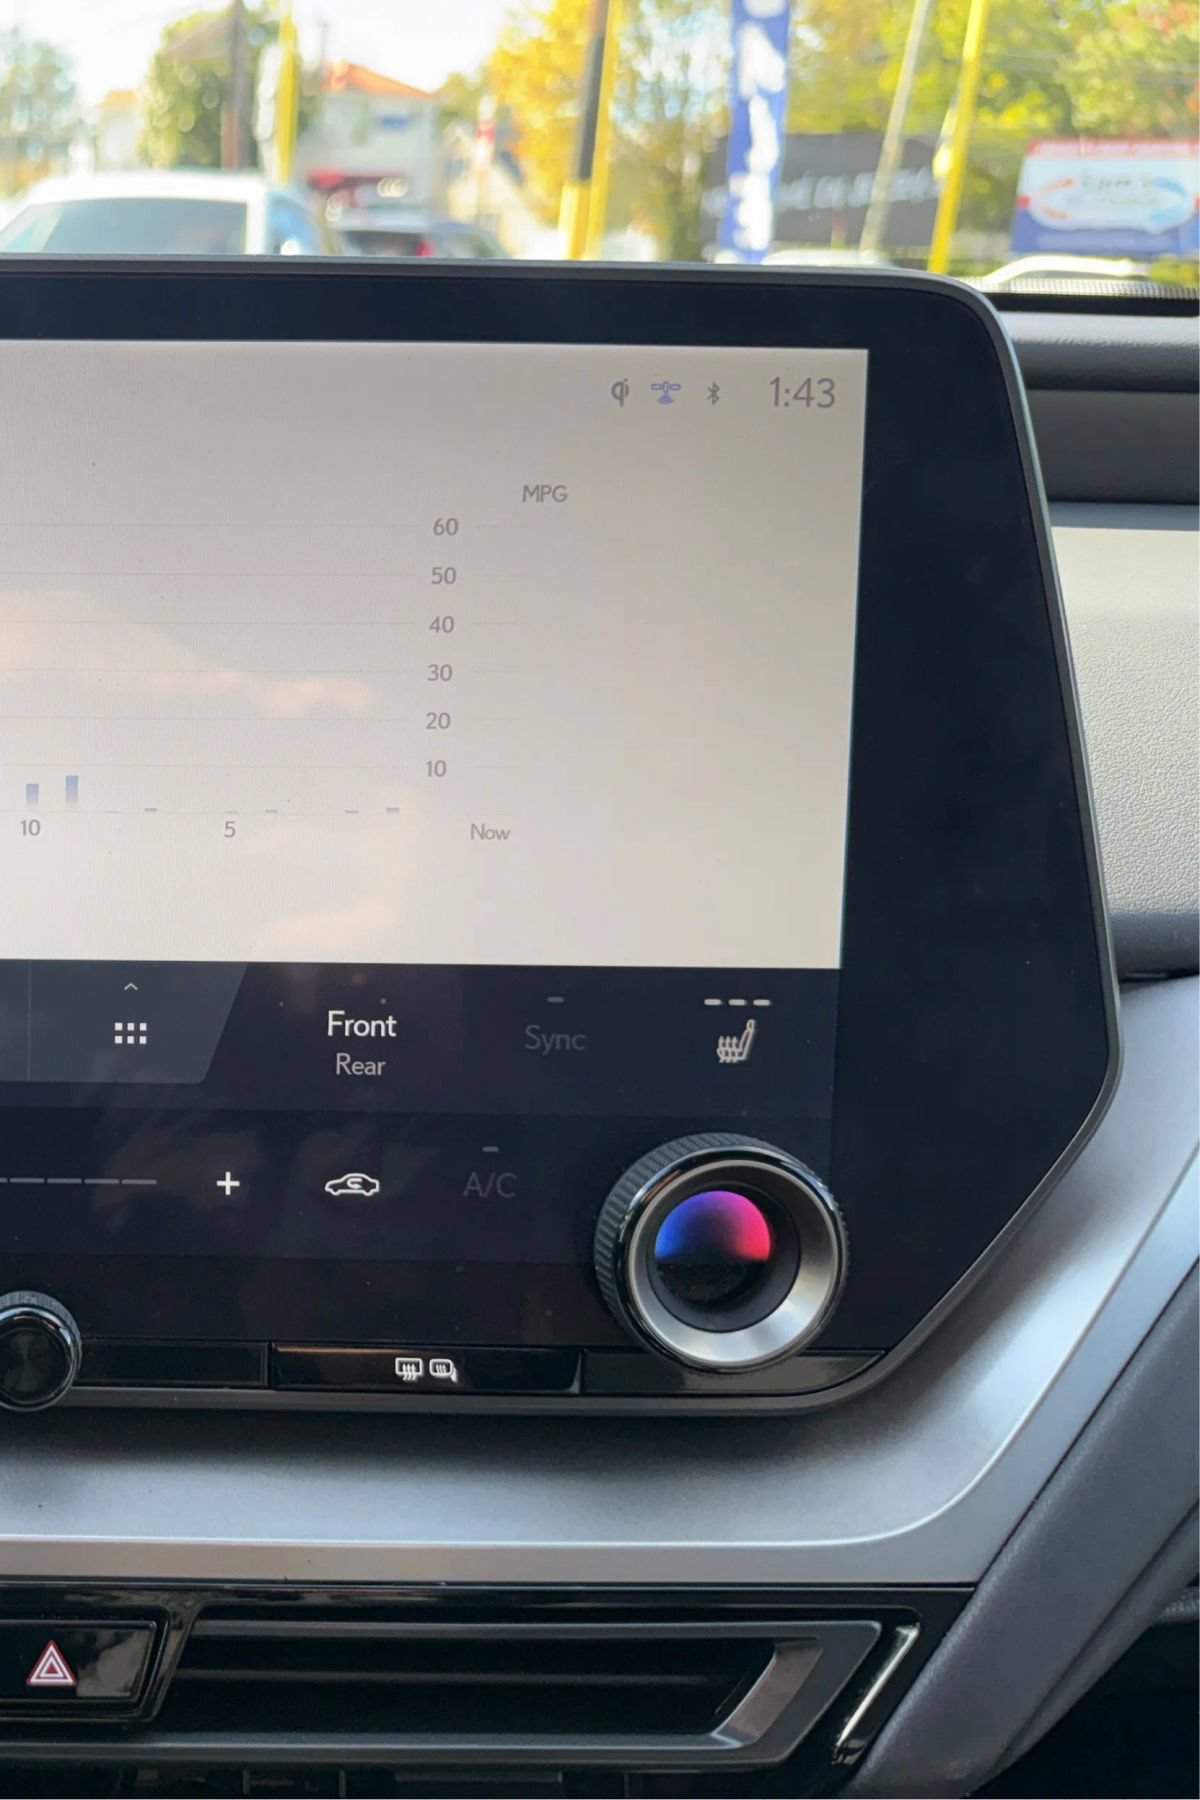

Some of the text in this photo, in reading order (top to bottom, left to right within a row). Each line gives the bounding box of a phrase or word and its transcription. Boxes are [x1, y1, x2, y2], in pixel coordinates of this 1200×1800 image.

[770, 376, 836, 409] 1:43
[521, 484, 569, 503] MPG
[432, 517, 459, 537] 60
[431, 566, 457, 585] 50
[428, 615, 455, 634] 40
[426, 663, 453, 682] 30
[425, 711, 451, 730] 20
[425, 759, 447, 778] 10
[20, 818, 41, 837] 10
[223, 820, 237, 839] 5
[470, 823, 512, 841] Now
[327, 1009, 398, 1038] Front
[525, 1024, 586, 1055] Sync
[335, 1052, 387, 1076] Rear
[463, 1171, 517, 1198] A/C
